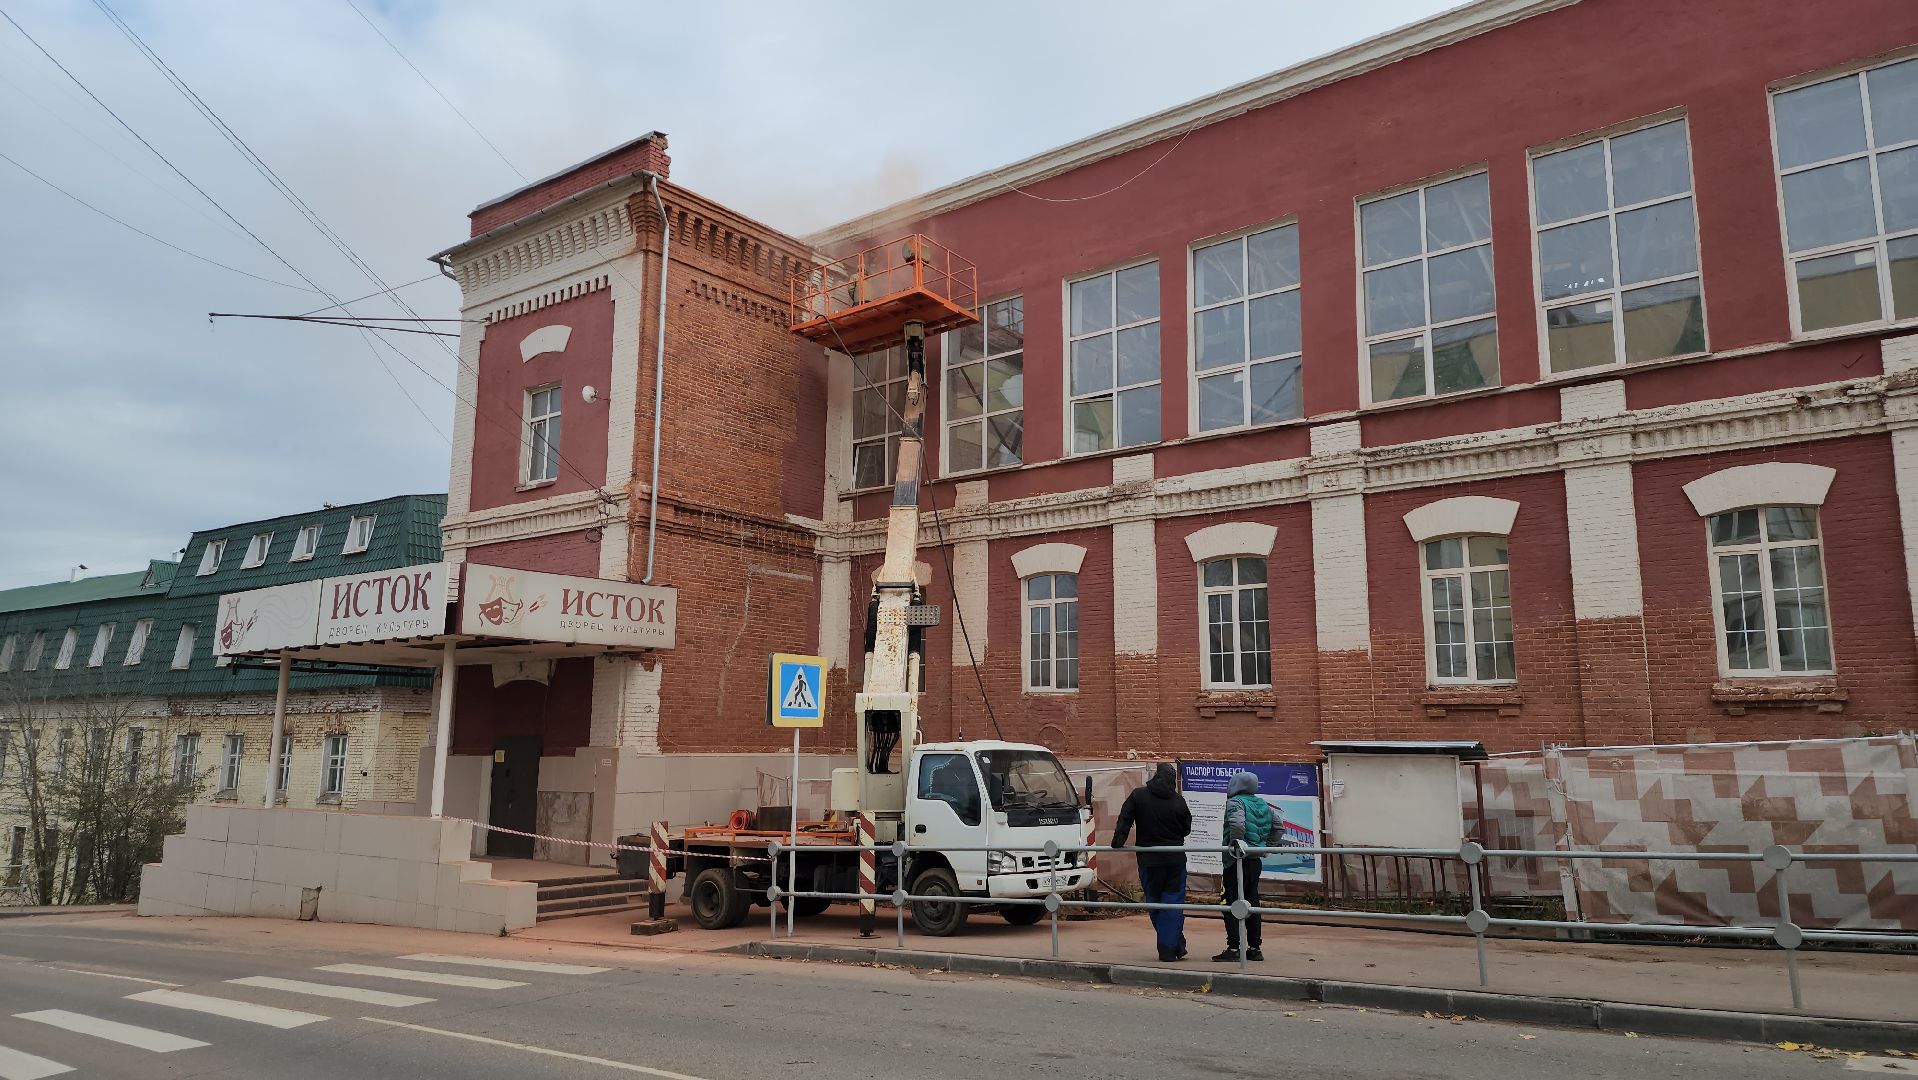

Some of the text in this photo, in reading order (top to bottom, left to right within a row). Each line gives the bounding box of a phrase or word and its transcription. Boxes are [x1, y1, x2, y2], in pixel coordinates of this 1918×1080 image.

[331, 571, 432, 620] ИСТОК
[561, 588, 665, 625] ИСТОК
[328, 619, 430, 639] ДВОРЕЦ КУЛЬТУРЫ
[560, 620, 665, 636] ДВОРЕЦ КУЛЬТУРЫ
[1185, 766, 1215, 776] ПАСПОРТ
[1038, 817, 1059, 825] ISUZU
